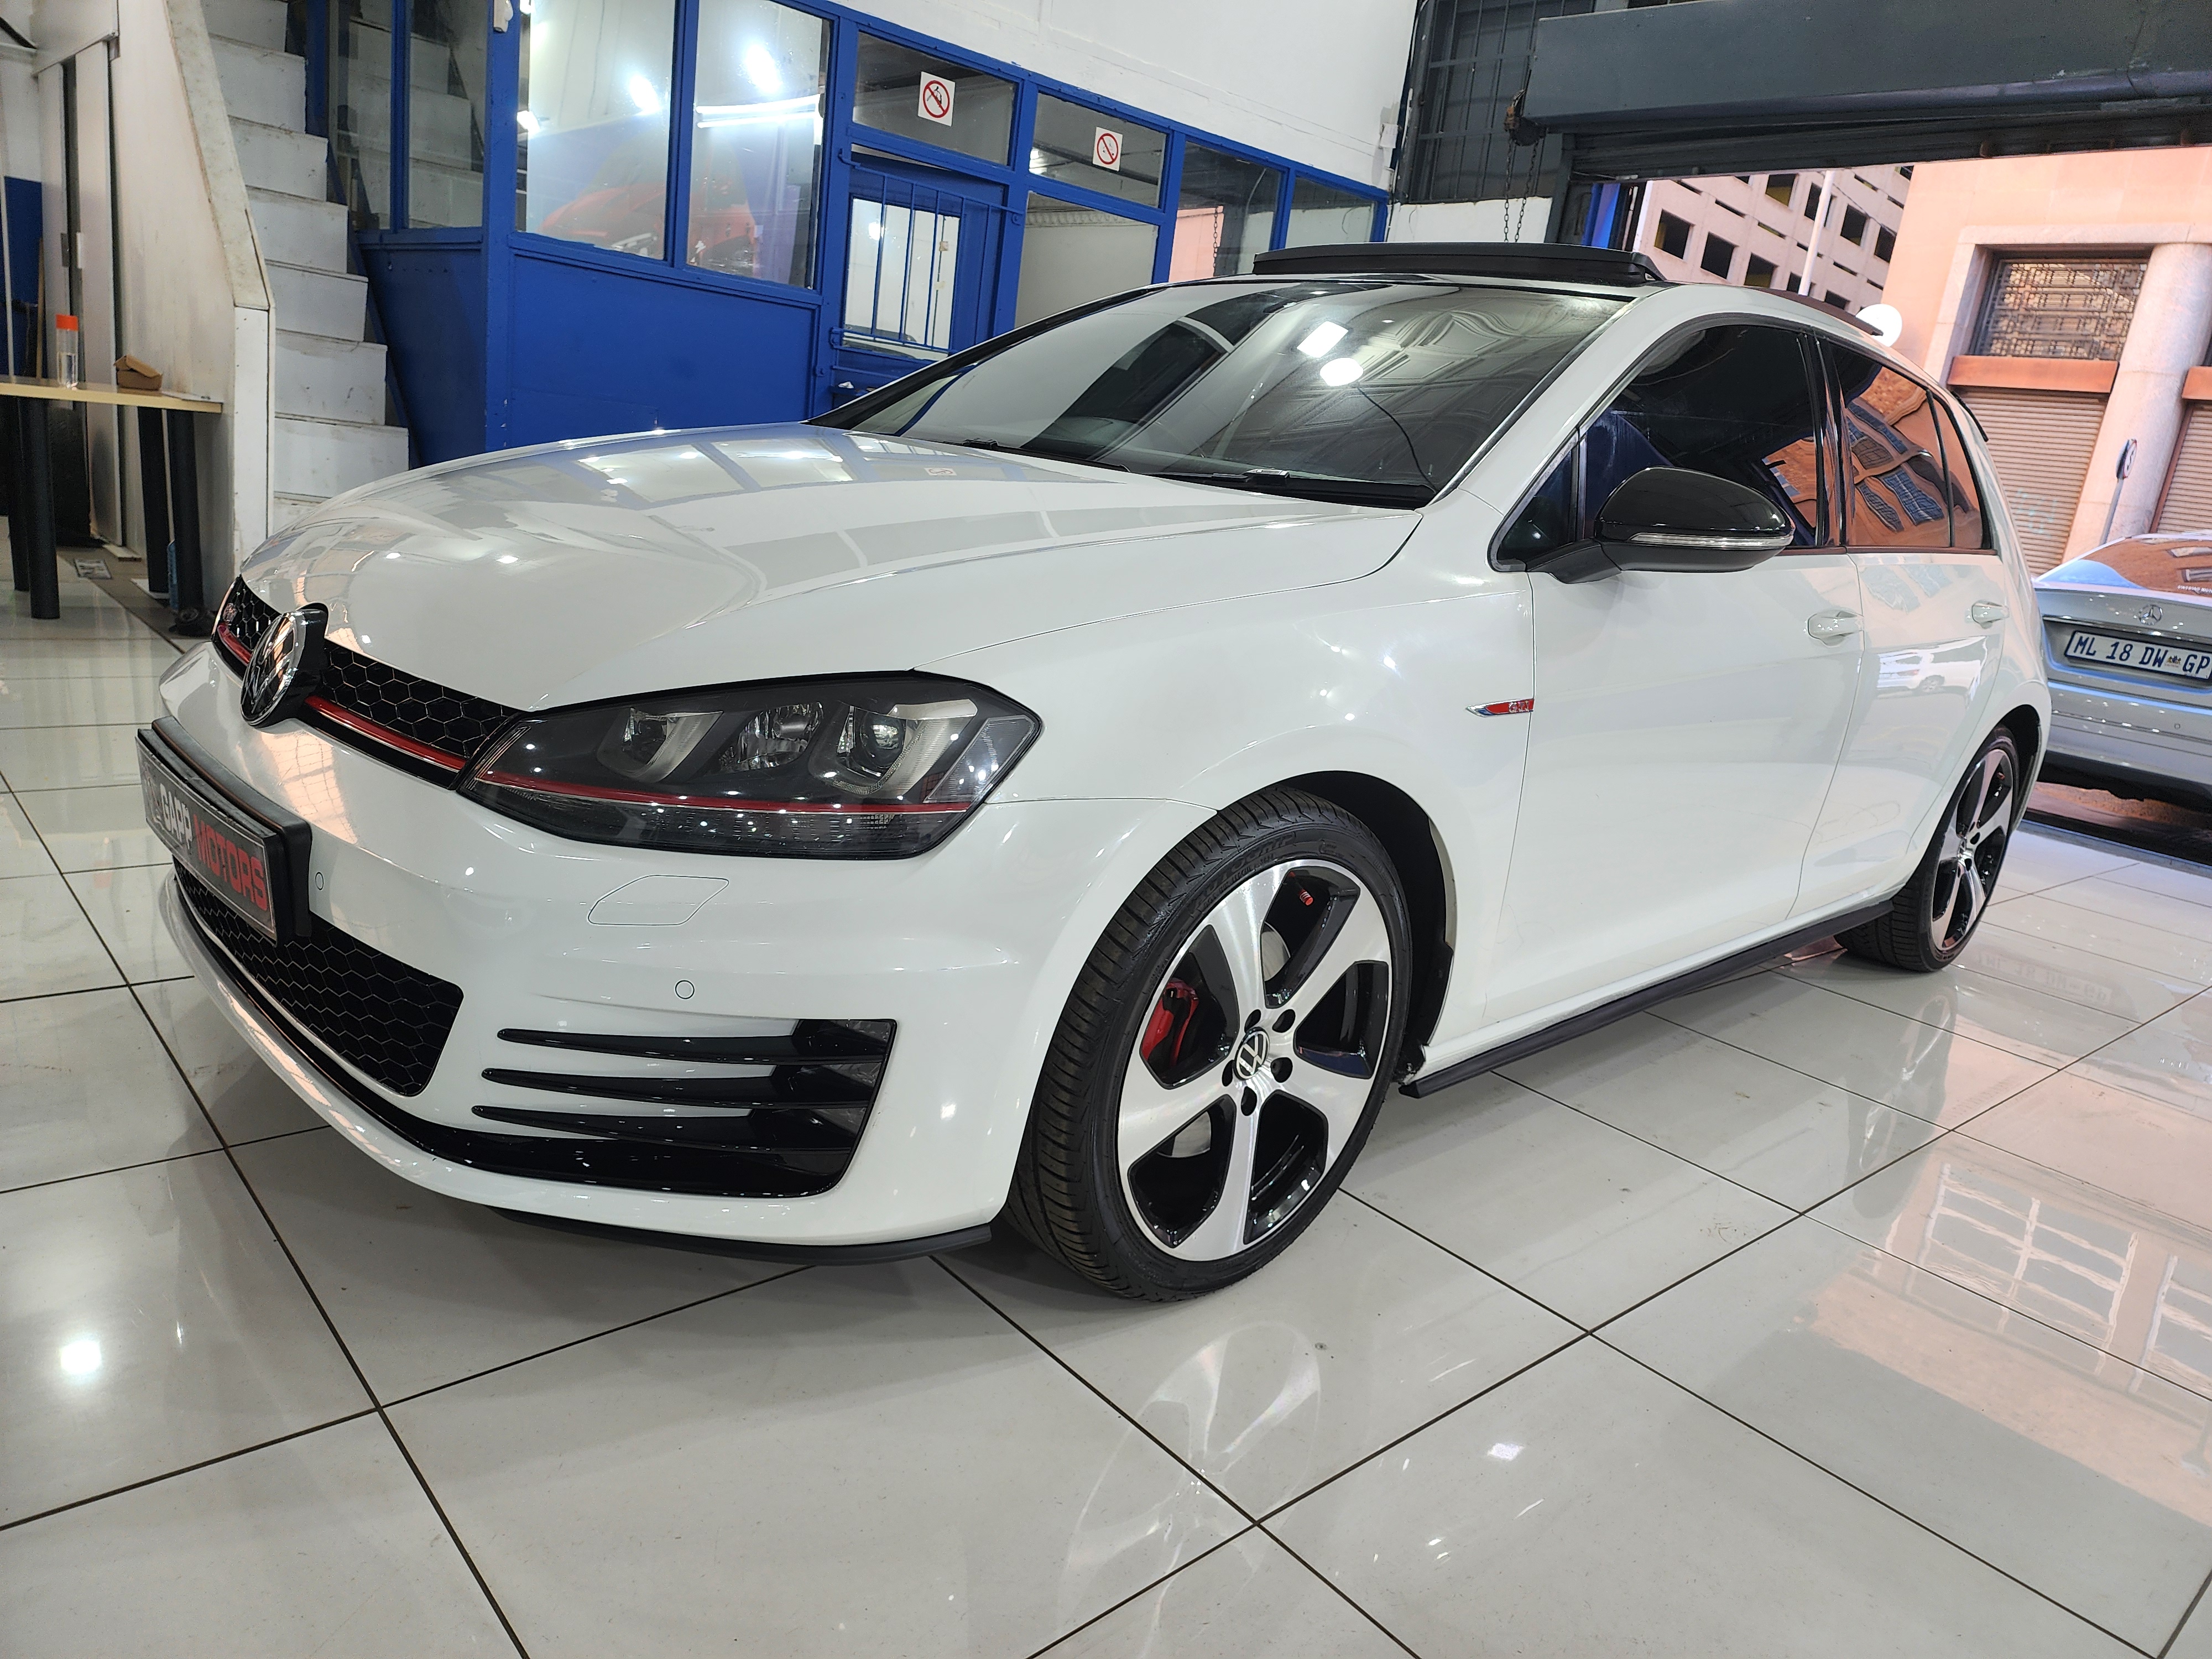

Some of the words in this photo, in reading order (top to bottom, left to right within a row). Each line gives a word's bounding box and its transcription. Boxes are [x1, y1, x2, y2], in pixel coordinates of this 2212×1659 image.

[2074, 636, 2096, 656] ML
[2105, 641, 2133, 661] 18
[2138, 646, 2168, 667] DW
[2182, 654, 2210, 674] GP
[1508, 700, 1530, 713] GTI
[160, 783, 192, 849] GAPP
[194, 814, 268, 911] MOTORS
